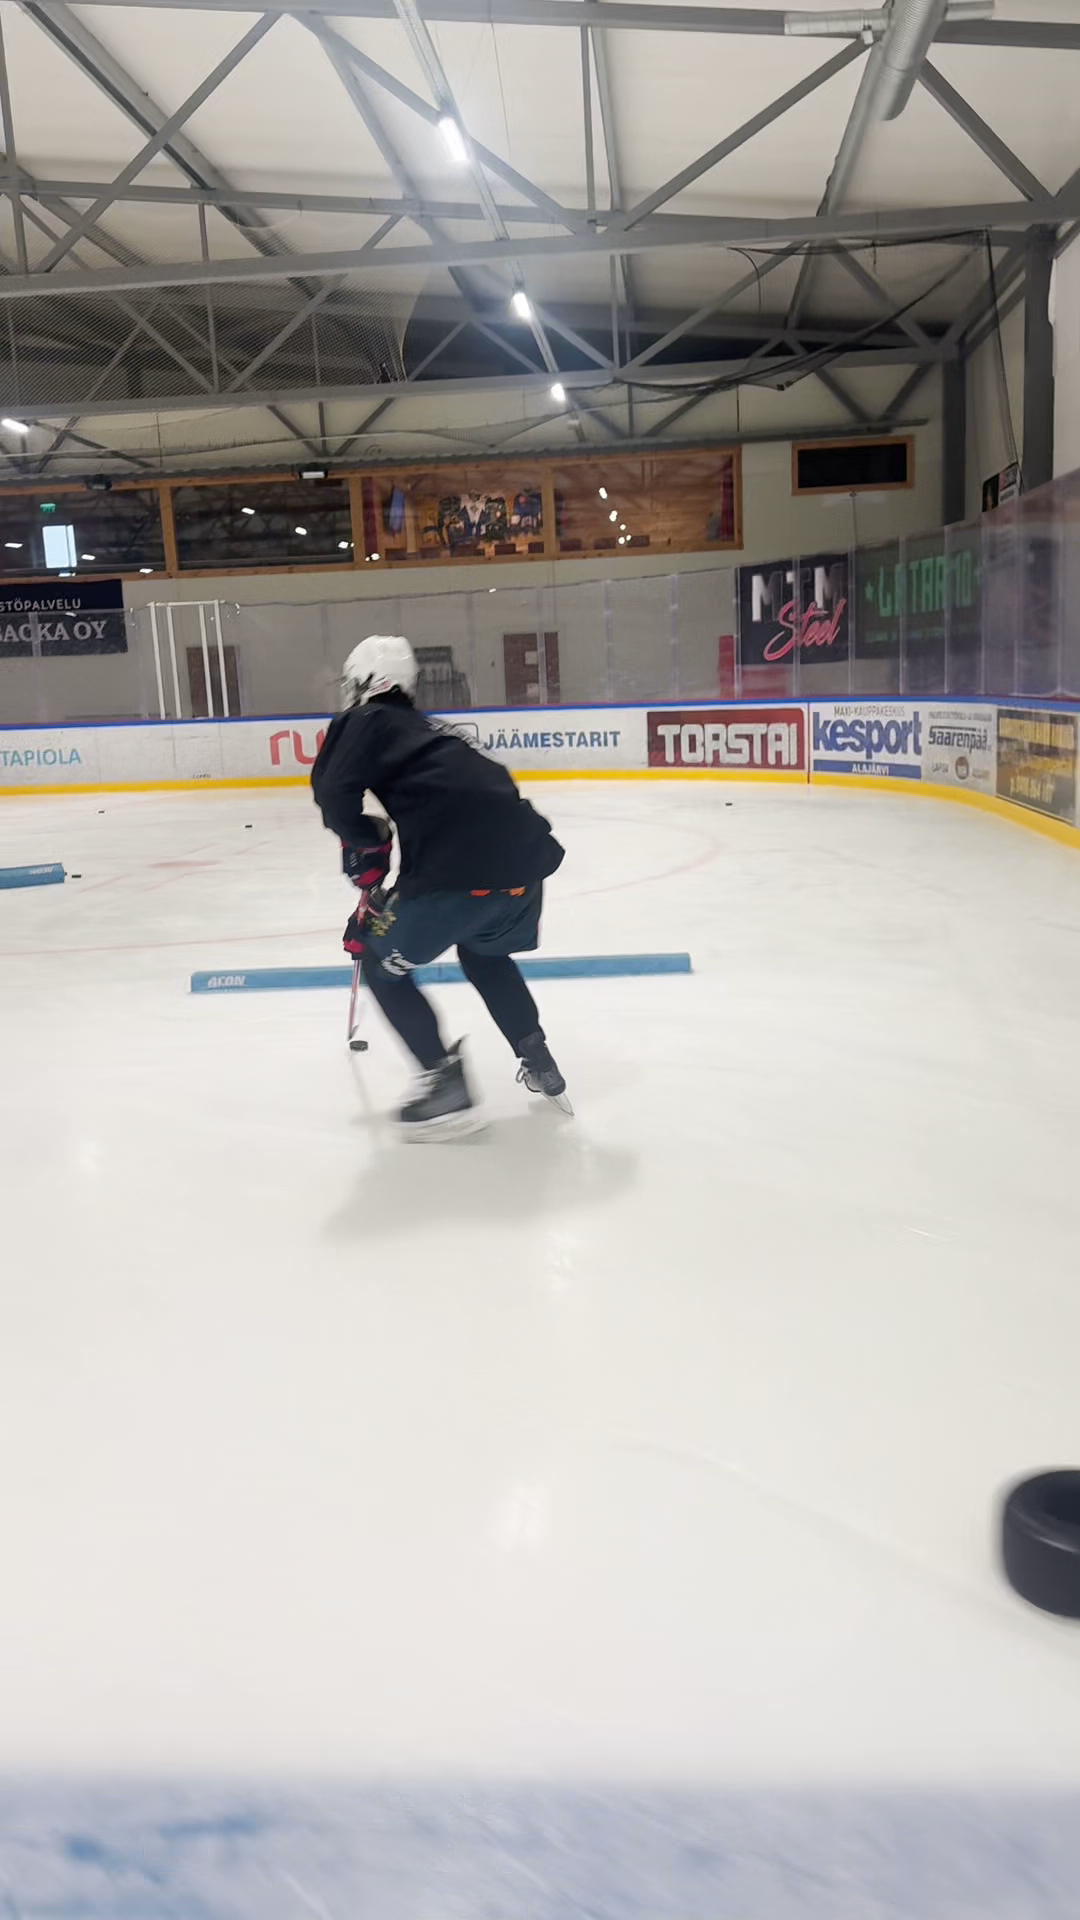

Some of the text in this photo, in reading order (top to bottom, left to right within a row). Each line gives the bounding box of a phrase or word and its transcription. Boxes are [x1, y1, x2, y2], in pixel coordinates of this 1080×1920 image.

[751, 562, 846, 622] MTM
[0, 620, 107, 643] ACKA OY
[763, 597, 847, 662] Steel
[483, 728, 621, 751] JÄÄMESTARIT
[657, 722, 798, 765] TORSTAI
[812, 711, 922, 760] kesport
